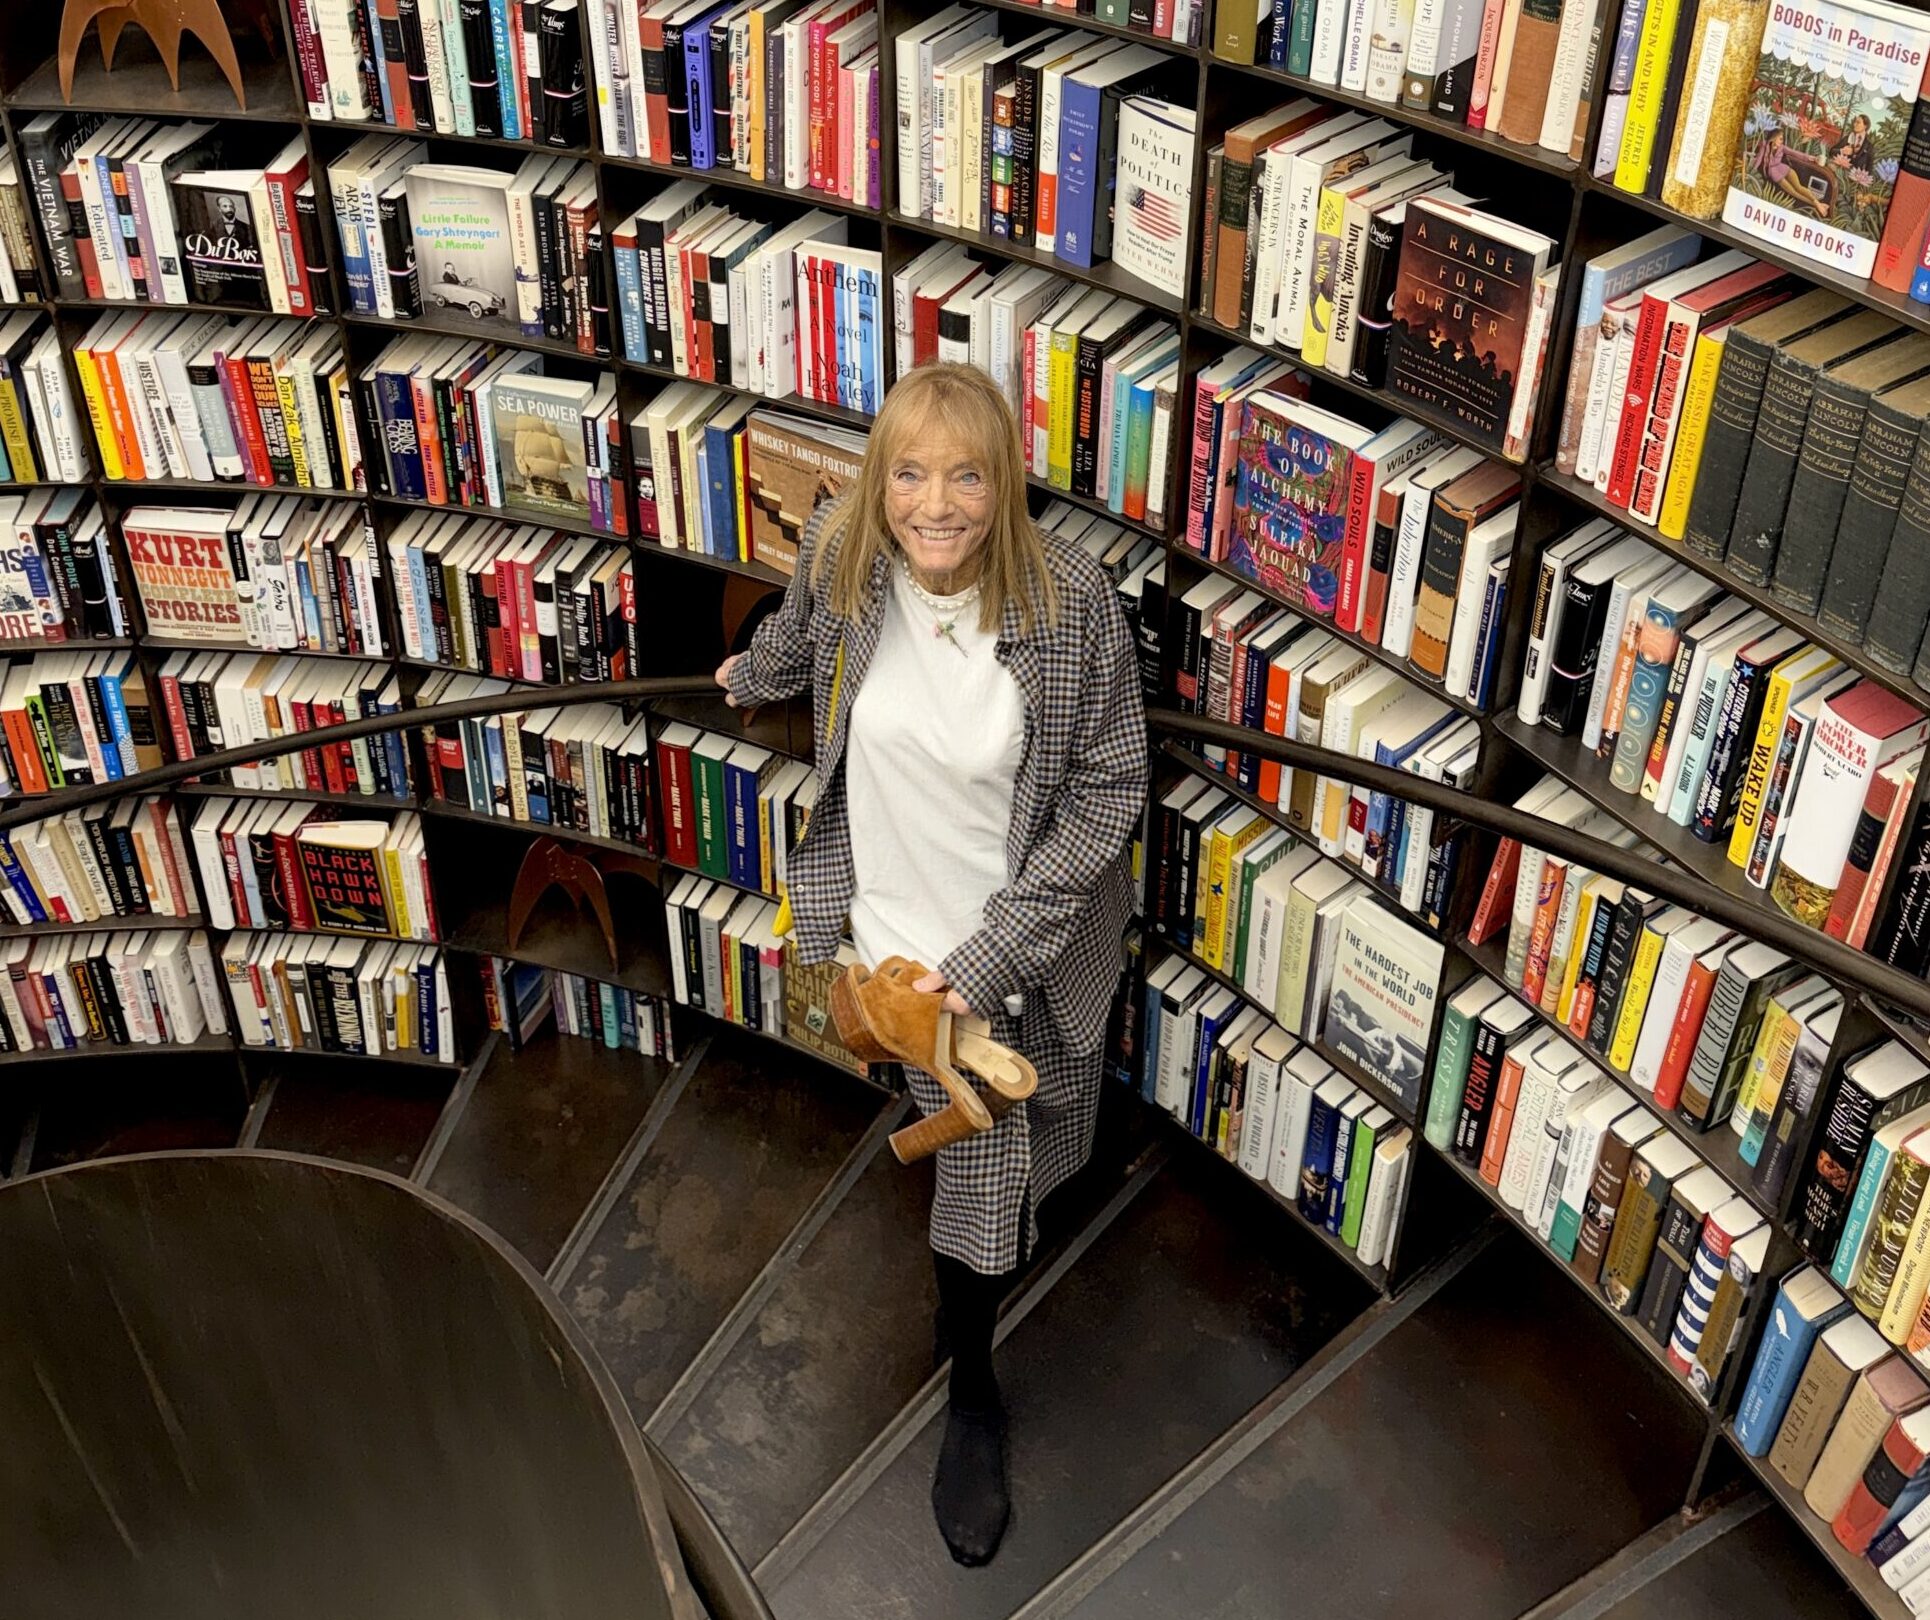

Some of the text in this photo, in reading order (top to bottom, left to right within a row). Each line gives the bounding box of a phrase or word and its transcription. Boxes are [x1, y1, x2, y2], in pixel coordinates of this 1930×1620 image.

[492, 6, 507, 59] CARREY
[606, 12, 617, 46] WALTER
[1447, 14, 1463, 66] PROMISED
[1773, 5, 1921, 67] BOBOS in Paradise
[1370, 59, 1399, 72] OBAMA
[1443, 69, 1454, 95] LAND
[617, 116, 626, 131] THE
[618, 132, 627, 146] DOG
[1622, 119, 1635, 165] SELINGO
[1131, 134, 1182, 167] DEATH
[1636, 123, 1646, 169] JEFFREY
[1120, 155, 1192, 200] POLITICS
[35, 158, 72, 277] THE VIETNAM WAR
[270, 182, 287, 232] BABYSITTER
[334, 194, 348, 221] JEW
[345, 184, 362, 222] ARAB
[361, 191, 376, 229] STEAL
[421, 214, 490, 225] Little Failure
[90, 203, 112, 262] Educated
[416, 227, 500, 238] Gary Shteyngart
[434, 241, 485, 250] A Memoir
[1289, 186, 1312, 313] THE MORAL ANIMAL
[1417, 223, 1514, 275] A RAGE
[1744, 205, 1855, 259] DAVID BROOKS
[650, 247, 668, 332] MAGGIE HABERMAN
[797, 260, 878, 298] Anthem
[1334, 222, 1364, 343] Inventing America
[1438, 266, 1485, 295] FOR
[1604, 252, 1672, 298] THE BEST
[809, 318, 868, 343] A Novel
[1414, 289, 1498, 337] ORDER
[139, 361, 160, 400] JUSTICE
[250, 362, 271, 377] WE
[250, 376, 273, 385] DON'T
[816, 353, 863, 381] Noah
[1722, 361, 1763, 383] LINCOLN
[1725, 350, 1768, 373] ABRAHAM
[252, 384, 276, 393] KNOW
[254, 392, 277, 401] OUR
[808, 369, 875, 406] Hawley
[1396, 378, 1438, 404] ROBERT
[1457, 406, 1493, 432] WORTH
[1606, 345, 1627, 425] MANDELA
[1615, 305, 1657, 485] INFORMATION WARS RICHARD STENGEL
[1765, 382, 1808, 407] LINCOLN
[1769, 371, 1812, 397] ABRAHAM
[5, 396, 22, 447] PROMISE
[88, 395, 103, 432] HABIT
[497, 395, 579, 424] SEA POWER
[1634, 322, 1690, 516] THE BREAKS OF THE GAME
[1674, 350, 1715, 508] MAKE RUSSIA GREAT AGAIN
[1813, 410, 1861, 432] LINCOLN
[1817, 398, 1864, 421] ABRAHAM
[278, 376, 309, 487] Dan Zak Almighty
[402, 418, 418, 454] BEARING
[1251, 419, 1336, 473] THE BOOK
[1863, 433, 1910, 458] LINCOLN
[1867, 421, 1914, 448] ABRAHAM
[751, 429, 862, 479] WHISKEY TANGO FOXTROT
[1279, 458, 1303, 476] OF
[1249, 471, 1327, 518] ALCHEMY
[55, 528, 80, 590] JOHN UPDIKE
[124, 531, 224, 569] KURT
[1249, 519, 1318, 563] SULEIKA
[1249, 540, 1313, 583] JAOUAD
[1342, 470, 1366, 611] WILD SOULS EMMA MARRIS
[134, 565, 231, 589] VONNEGUT
[138, 584, 238, 602] COMPLETE
[412, 559, 430, 634] SQUEEZED
[622, 577, 636, 620] UFO
[145, 598, 241, 624] STORIES
[575, 596, 590, 647] Philip Roth
[1533, 564, 1555, 638] Pandaemonium
[1267, 700, 1282, 711] DEAR
[1267, 710, 1281, 720] LIFE
[1689, 691, 1713, 739] PUZZLER
[1728, 684, 1750, 736] CITIZENS OF
[1650, 701, 1675, 762] MARK BOWDEN
[1816, 725, 1868, 769] BROKER
[1821, 719, 1867, 758] POWER
[1834, 720, 1855, 738] THE
[1706, 786, 1722, 812] MARK
[1743, 744, 1772, 827] WAKE UP
[670, 785, 683, 830] MARK TWAIN
[304, 849, 375, 872] BLACK
[309, 867, 378, 889] HAWK
[314, 888, 383, 907] DOWN
[1344, 928, 1434, 1001] THE HARDEST JOB
[1354, 958, 1418, 1006] IN THE WORLD
[1341, 964, 1426, 1028] THE AMERICAN PRESIDENCY
[333, 999, 362, 1044] RECKONING
[1693, 969, 1746, 1092] ROBERT BLY
[786, 1022, 859, 1067] PHILIP ROTH
[1437, 1016, 1461, 1089] TRUST
[1336, 1041, 1404, 1097] JOHN DICKERSON
[1467, 1052, 1492, 1112] ANGLER
[1795, 1073, 1815, 1112] SHIRLEY
[1826, 1080, 1857, 1147] RUSHDIE
[1841, 1091, 1873, 1158] SALMAN
[1807, 1187, 1838, 1216] MOOR'S
[1807, 1200, 1830, 1222] LAST
[1814, 1184, 1832, 1201] THE
[1892, 1173, 1922, 1237] ALICE
[1805, 1209, 1827, 1231] SIGH
[1871, 1237, 1902, 1304] MUNRO
[1765, 1343, 1785, 1394] ANGLER
